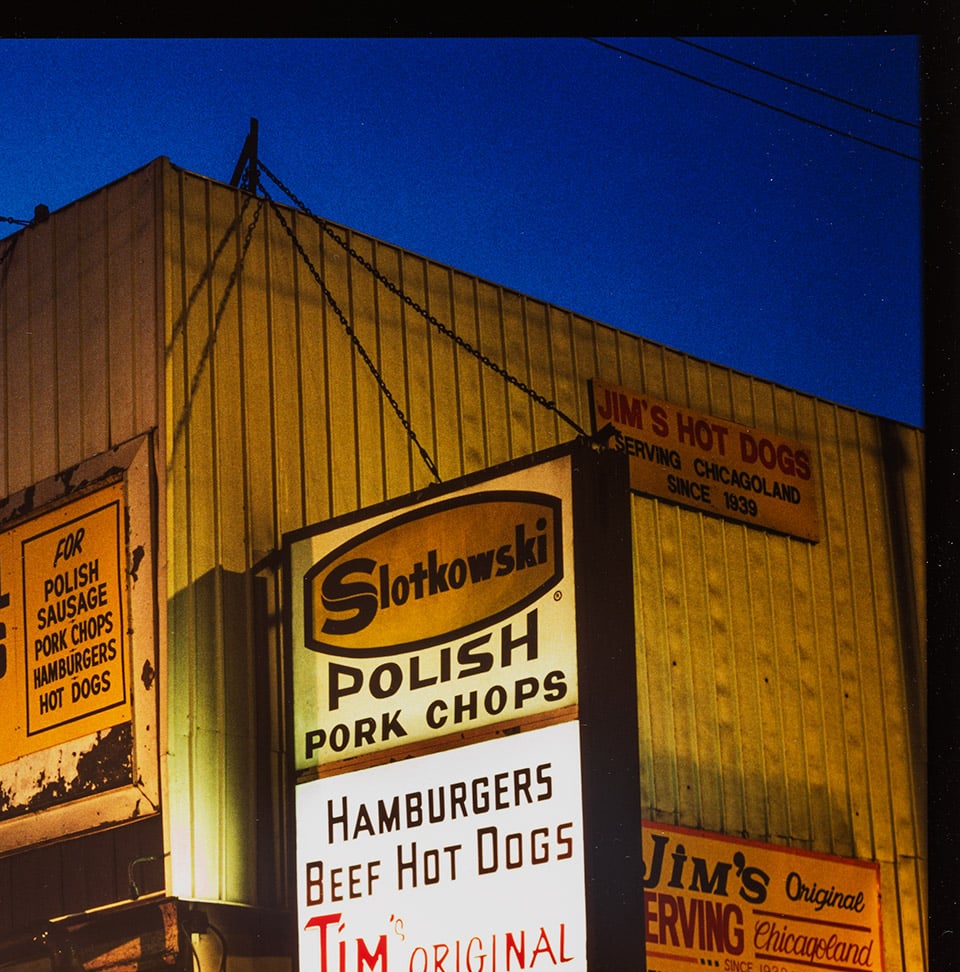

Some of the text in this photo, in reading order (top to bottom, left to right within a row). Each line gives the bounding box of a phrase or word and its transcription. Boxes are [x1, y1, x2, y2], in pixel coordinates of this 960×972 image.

[598, 389, 811, 480] JIM'S HOT DOGS
[615, 434, 800, 504] SERVING CHICAGOLAND
[667, 475, 757, 517] SINCE 1939
[53, 528, 85, 567] FOR
[321, 517, 548, 635] Slotkowski
[37, 583, 107, 630] SAUSAGE
[44, 559, 99, 602] POLISH
[34, 638, 117, 689] HAMBURGERS
[35, 613, 113, 661] PORK CHOPS
[329, 608, 538, 711] POLISH
[40, 671, 111, 715] HOT DOGS
[305, 670, 567, 759] PORK CHOPS
[327, 762, 552, 844] HAMBURGERS
[306, 822, 573, 907] BEEF HOT DOGS
[786, 871, 865, 913] Original
[644, 890, 873, 967] ERVING Chicagoland
